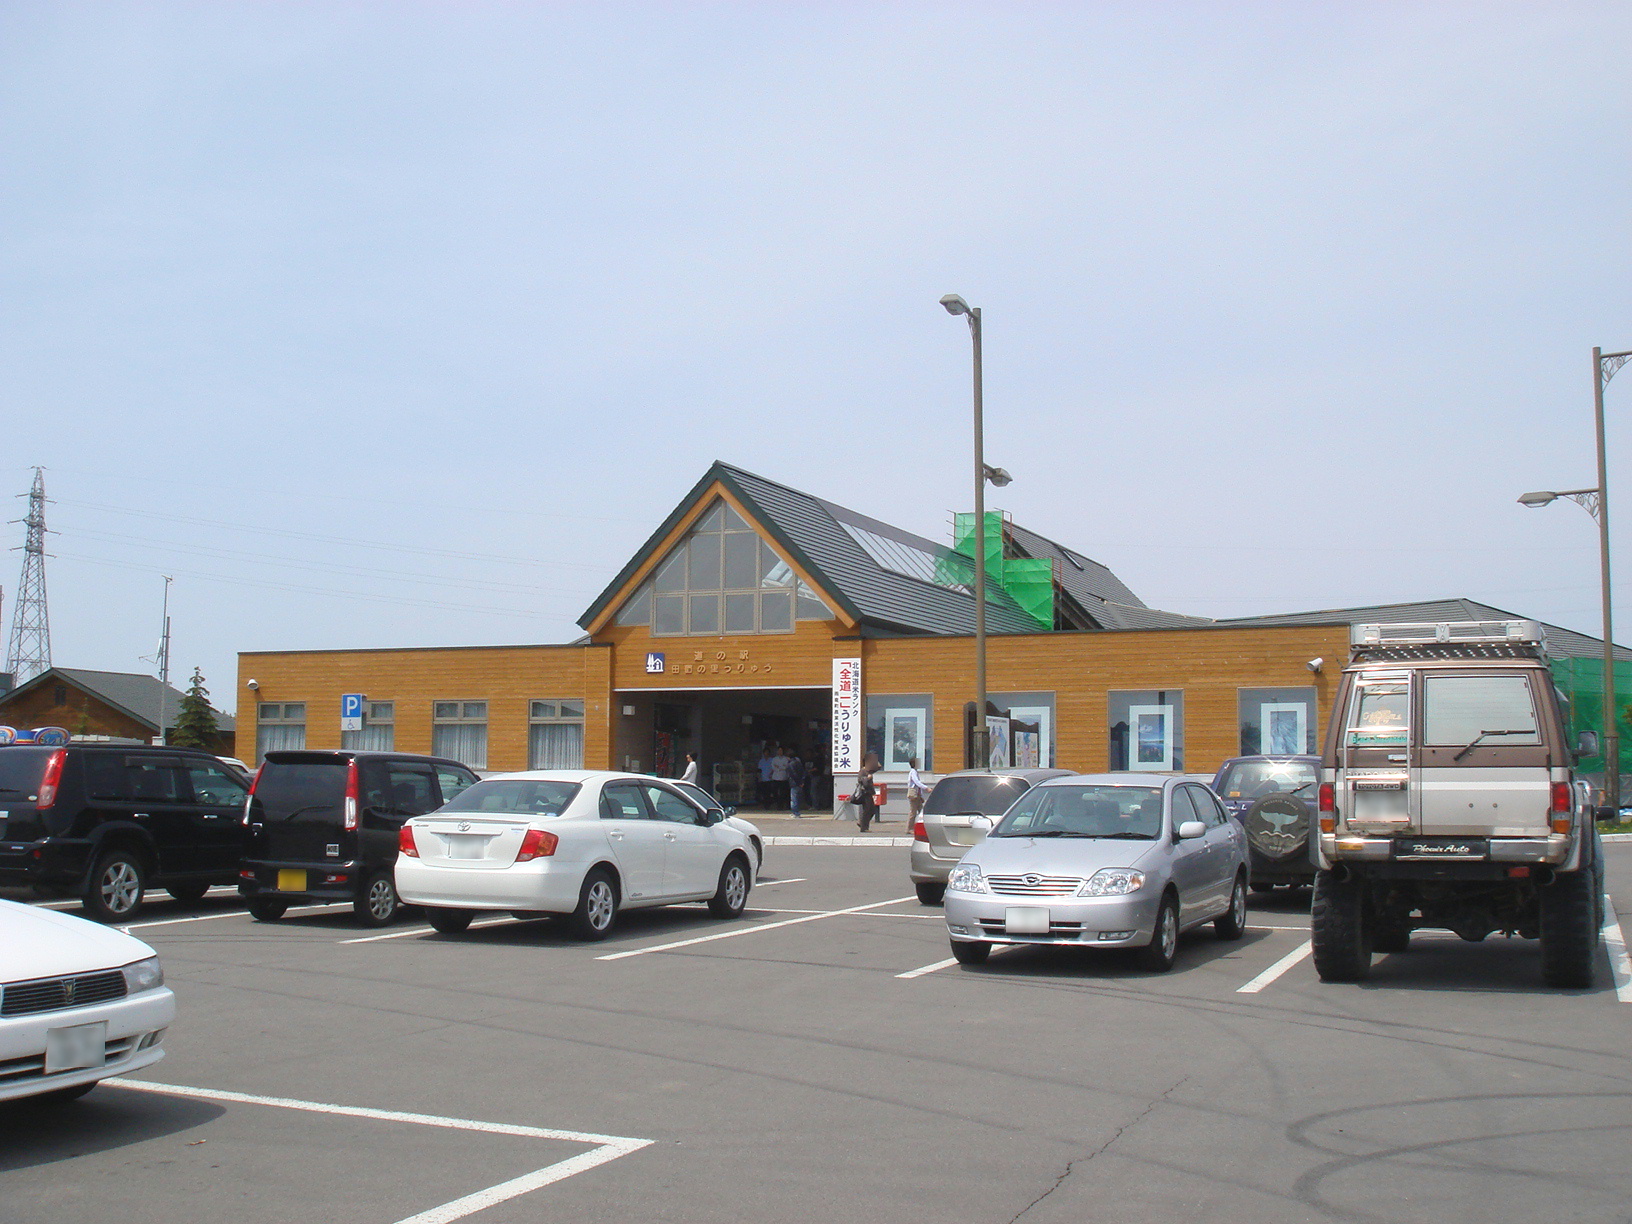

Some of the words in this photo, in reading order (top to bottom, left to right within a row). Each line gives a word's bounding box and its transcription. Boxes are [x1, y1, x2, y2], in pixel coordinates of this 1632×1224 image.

[693, 650, 749, 661] 道の駅
[851, 661, 860, 717] 北海道米ランク
[346, 696, 358, 716] P
[1412, 844, 1444, 853] Phoenix
[1444, 844, 1470, 853] Auto
